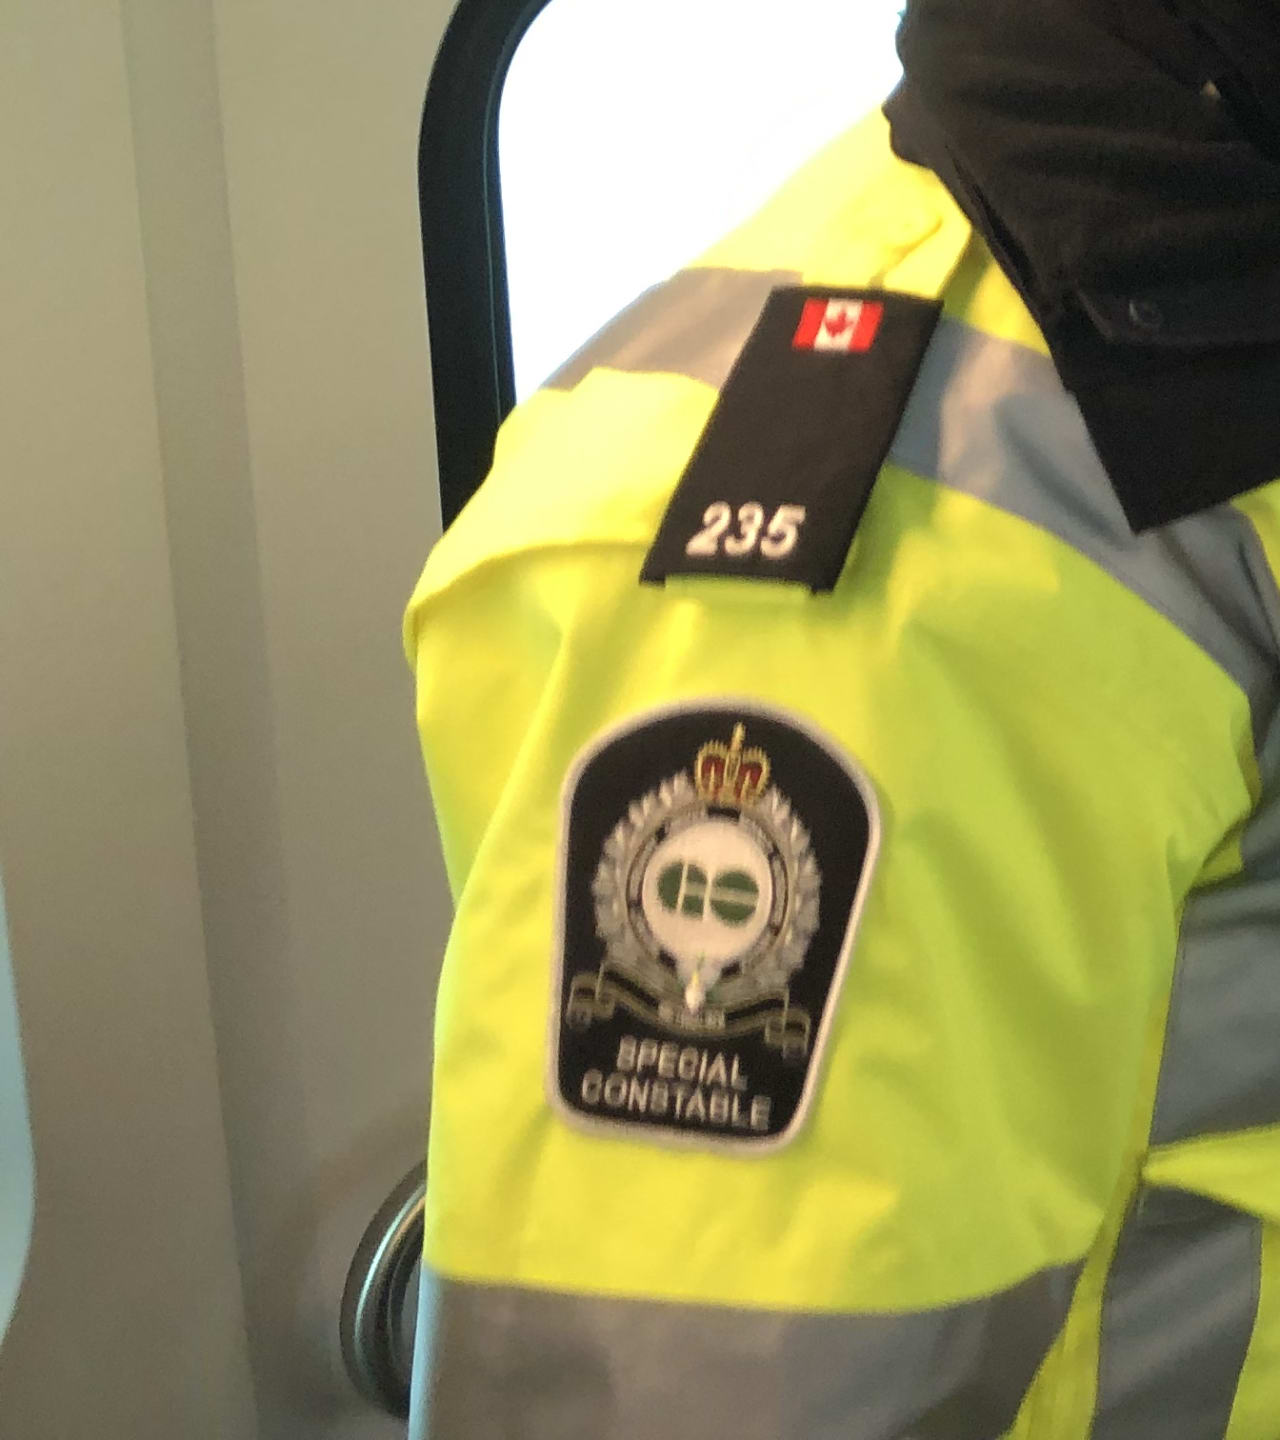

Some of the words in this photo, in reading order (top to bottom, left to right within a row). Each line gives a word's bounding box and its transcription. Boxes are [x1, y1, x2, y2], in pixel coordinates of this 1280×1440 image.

[685, 499, 807, 560] 235
[616, 1035, 749, 1091] SPECIAL
[581, 1068, 772, 1132] CONSTABLE
